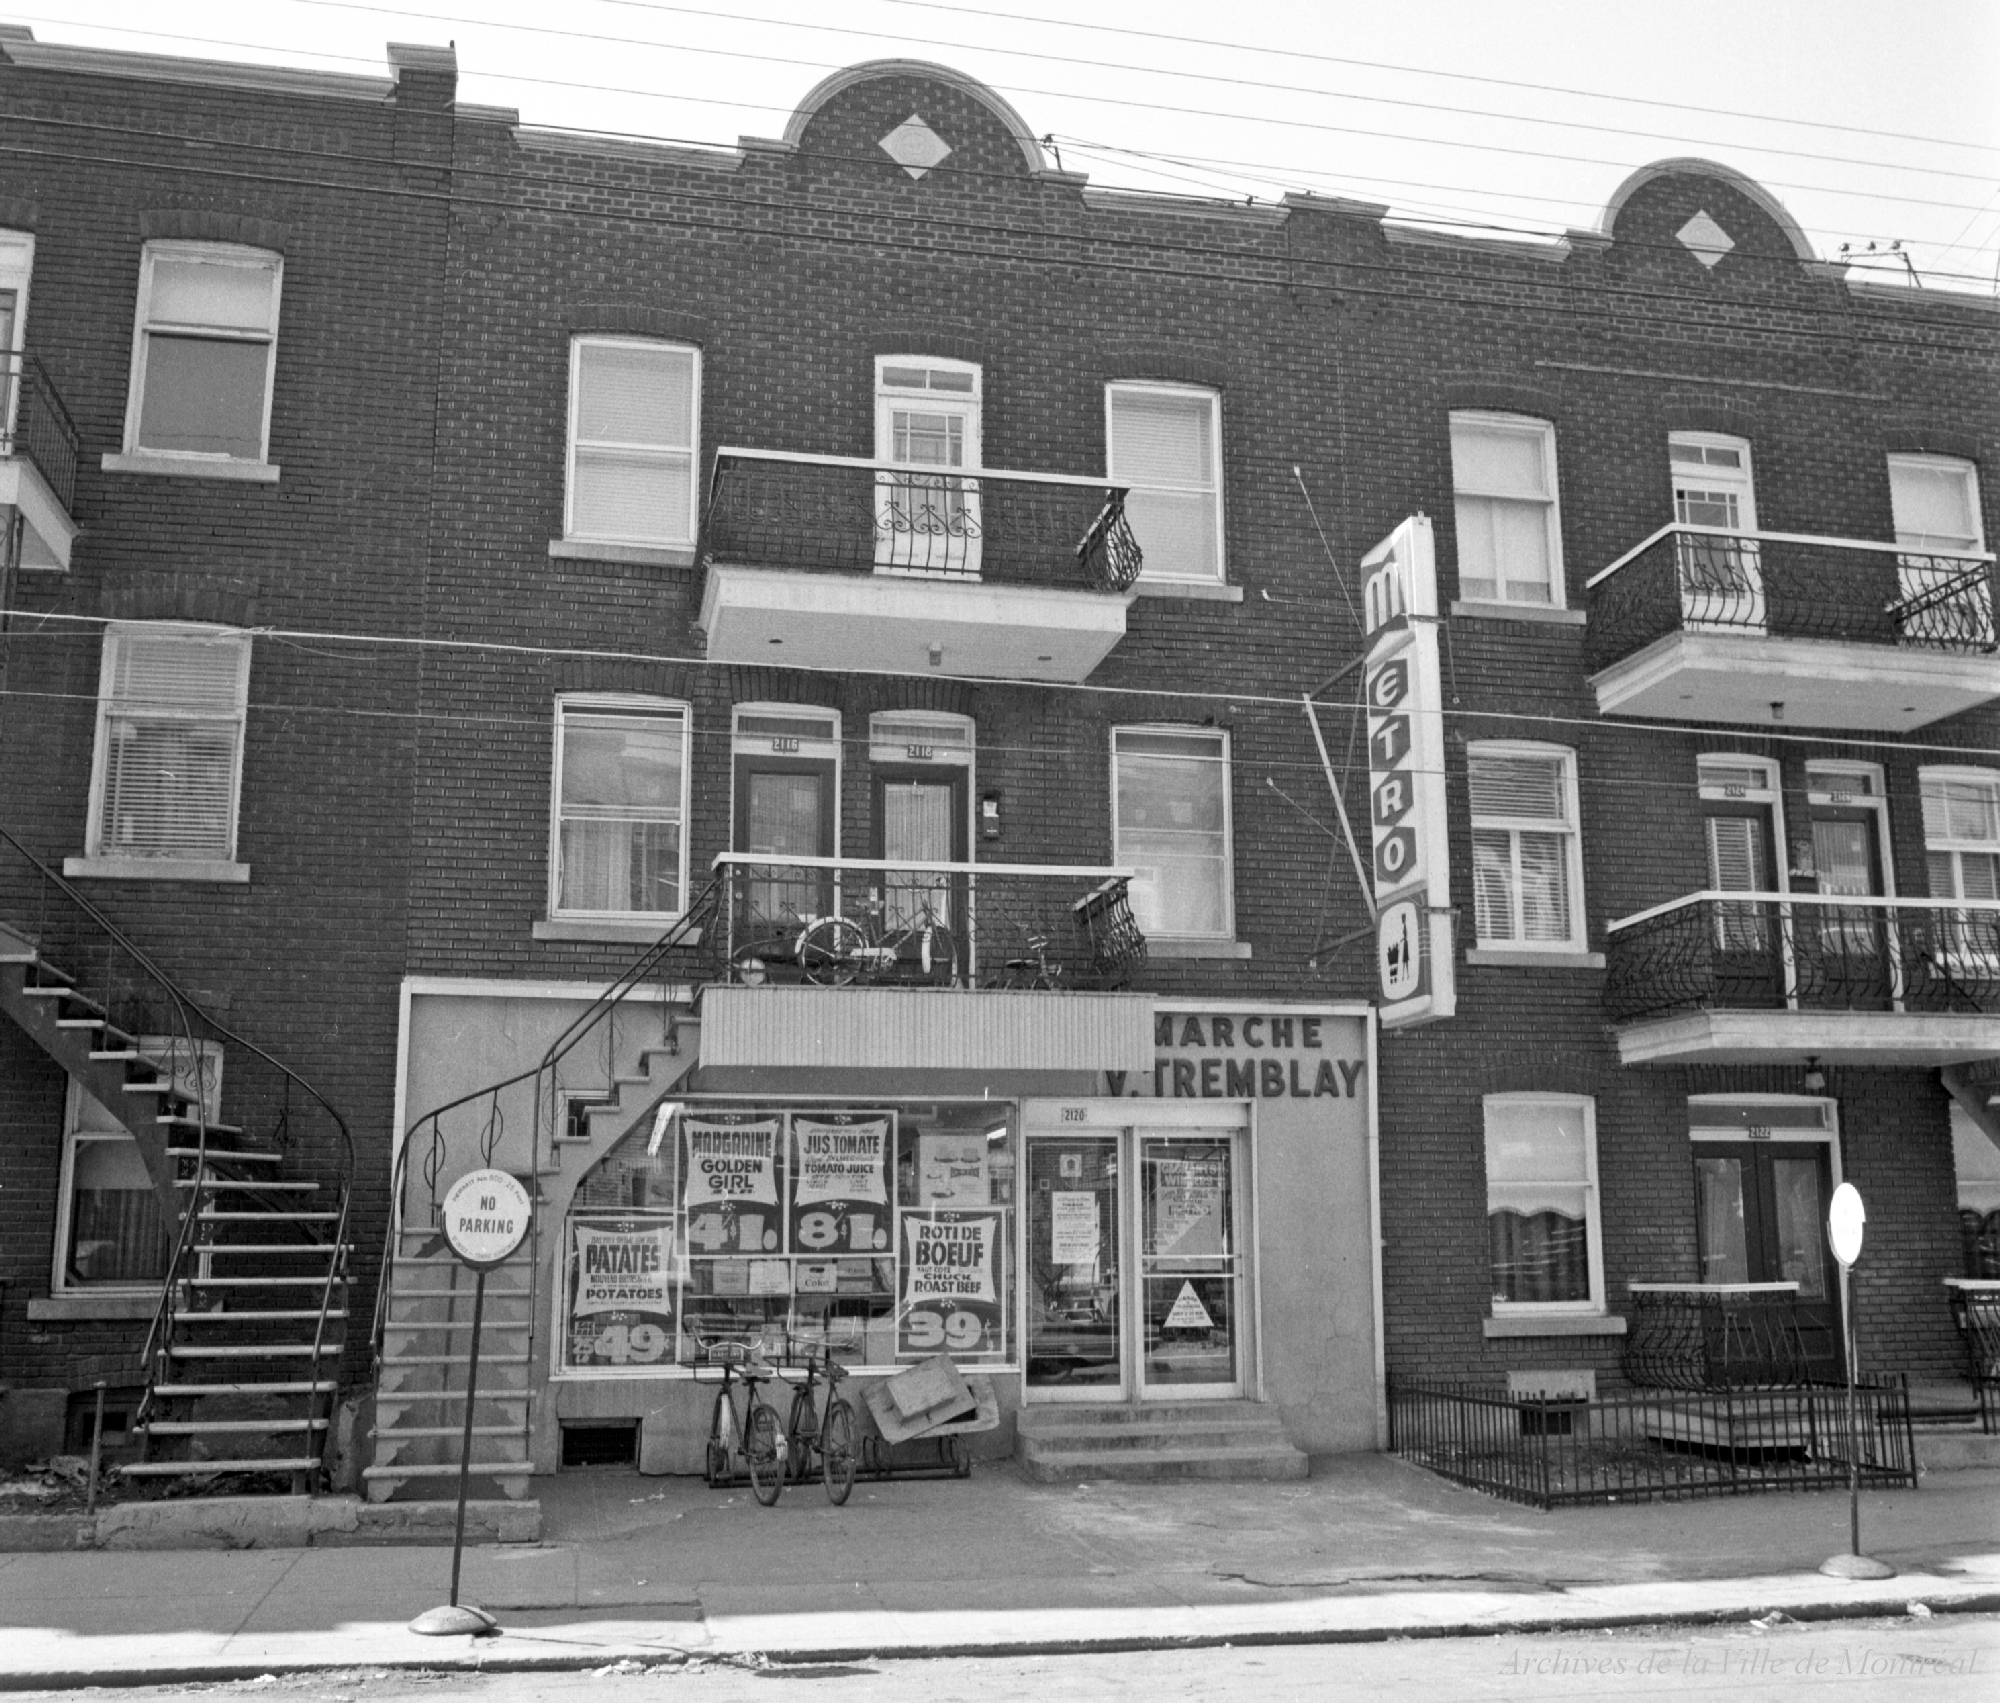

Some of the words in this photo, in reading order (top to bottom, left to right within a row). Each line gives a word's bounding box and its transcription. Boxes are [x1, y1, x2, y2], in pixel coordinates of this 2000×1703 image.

[773, 739, 798, 750] 2116
[1155, 1016, 1323, 1048] MARCHE
[1155, 1058, 1364, 1098] TREMBLAY
[1064, 1108, 1085, 1122] 2120
[1750, 1127, 1770, 1138] 2122
[692, 1131, 771, 1158] MARGARINE
[833, 1135, 880, 1154] TOMATE
[701, 1159, 762, 1174] GOLDEN
[805, 1163, 845, 1174] TOMATO
[847, 1164, 874, 1174] JUICE
[708, 1174, 754, 1189] GIRL
[480, 1195, 496, 1211] NO
[459, 1217, 514, 1235] PARKING
[920, 1225, 958, 1240] ROTI
[962, 1226, 982, 1240] DE
[586, 1244, 660, 1274] PATATES
[915, 1240, 984, 1268] BOEUF
[590, 1274, 618, 1284] NOUVEAU
[804, 1278, 829, 1288] Coke
[923, 1273, 972, 1281] CHUCK
[586, 1289, 663, 1299] POTATOES
[914, 1280, 955, 1293] ROAST
[957, 1281, 982, 1294] BEEF
